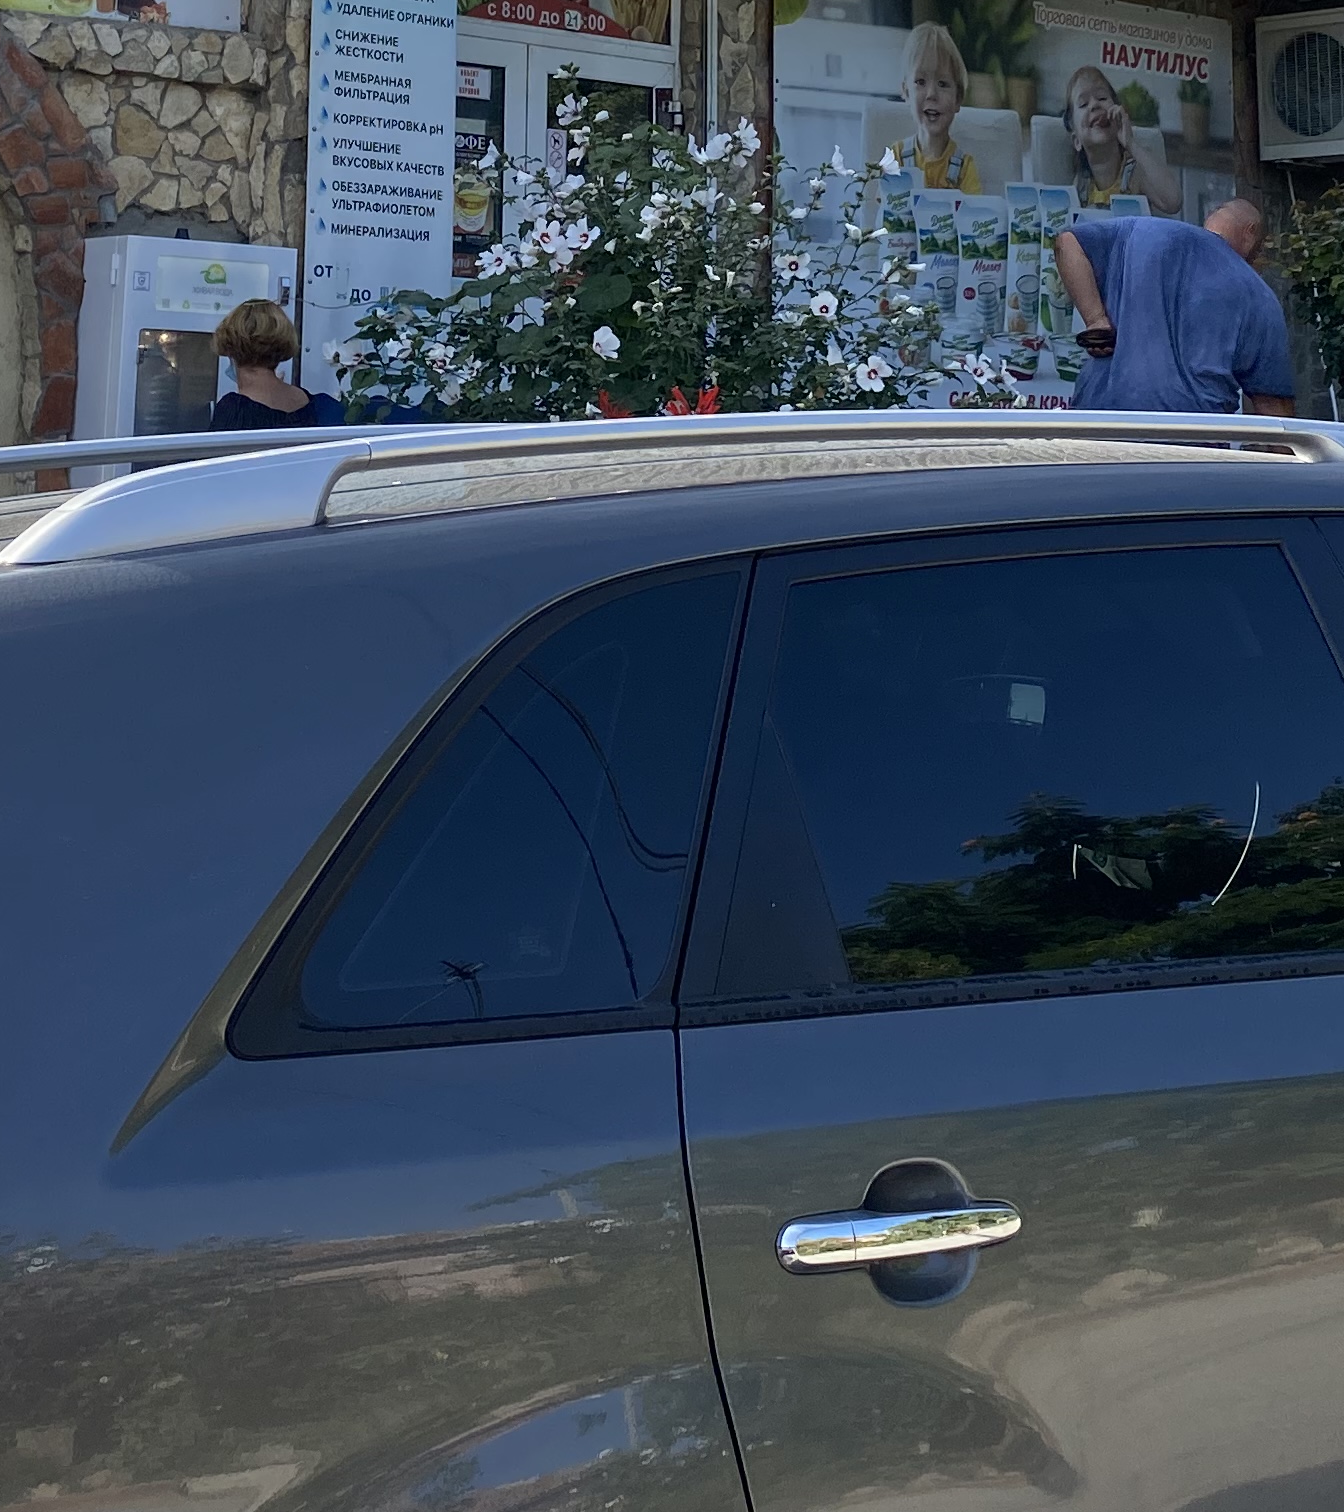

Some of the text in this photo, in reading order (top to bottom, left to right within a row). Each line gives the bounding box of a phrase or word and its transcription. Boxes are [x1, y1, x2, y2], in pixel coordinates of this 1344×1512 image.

[336, 1, 455, 30] УДАЛЕНИЕ ОРГАНИКИ
[501, 0, 535, 22] 8:00
[539, 11, 560, 28] до
[565, 10, 606, 32] 21:00
[1035, 3, 1086, 28] Торговая
[1087, 17, 1117, 33] сеть
[1118, 25, 1176, 45] магазинов
[1185, 29, 1213, 51] дома
[335, 28, 399, 47] СНИЖЕНИЕ
[334, 44, 404, 64] ЖЕСТКОСТИ
[1102, 41, 1208, 80] НАУТИЛУС
[334, 69, 412, 89] МЕМБРАННАЯ
[334, 86, 410, 105] ФИЛЬТРАЦИЯ
[333, 112, 428, 134] КОРРЕКТИРОВКА
[332, 137, 401, 155] УЛУЧШЕНИЕ
[455, 134, 487, 150] ОФЕ
[332, 155, 445, 176] ВКУСОВЫХ КАЧЕСТВ
[331, 180, 443, 201] ОБЕЗЗАРАЖИВАНИЕ
[331, 198, 435, 217] УЛЬТРАФИОЛЕТОМ
[330, 222, 430, 242] МИНЕРАЛИЗАЦИЯ
[313, 265, 333, 279] ОТ
[350, 288, 372, 303] ДО
